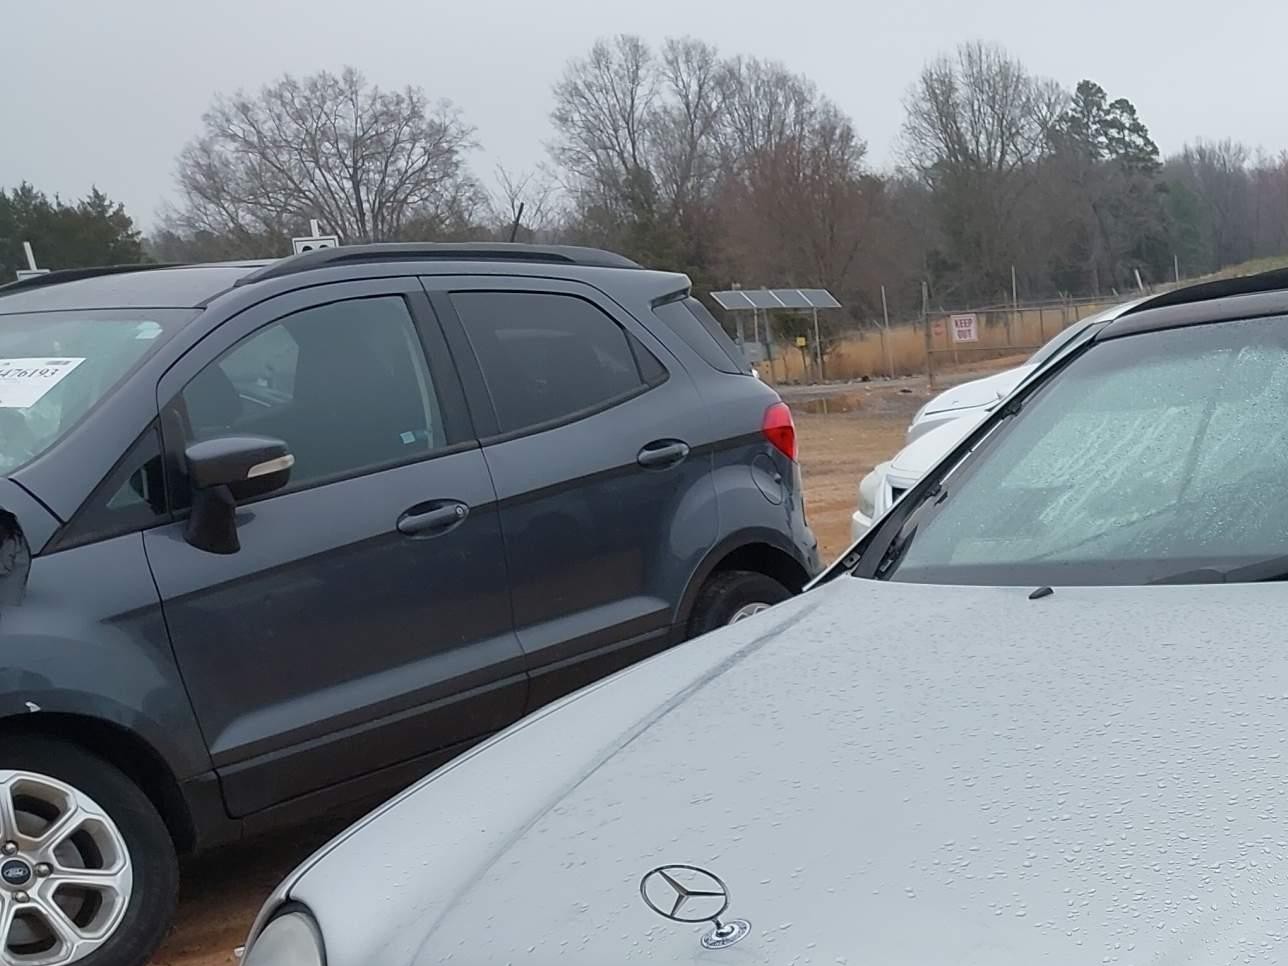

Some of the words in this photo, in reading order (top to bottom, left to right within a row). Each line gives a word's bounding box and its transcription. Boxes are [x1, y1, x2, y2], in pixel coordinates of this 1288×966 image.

[954, 318, 973, 328] KEEP
[957, 329, 972, 339] OUT
[0, 368, 59, 378] 476193
